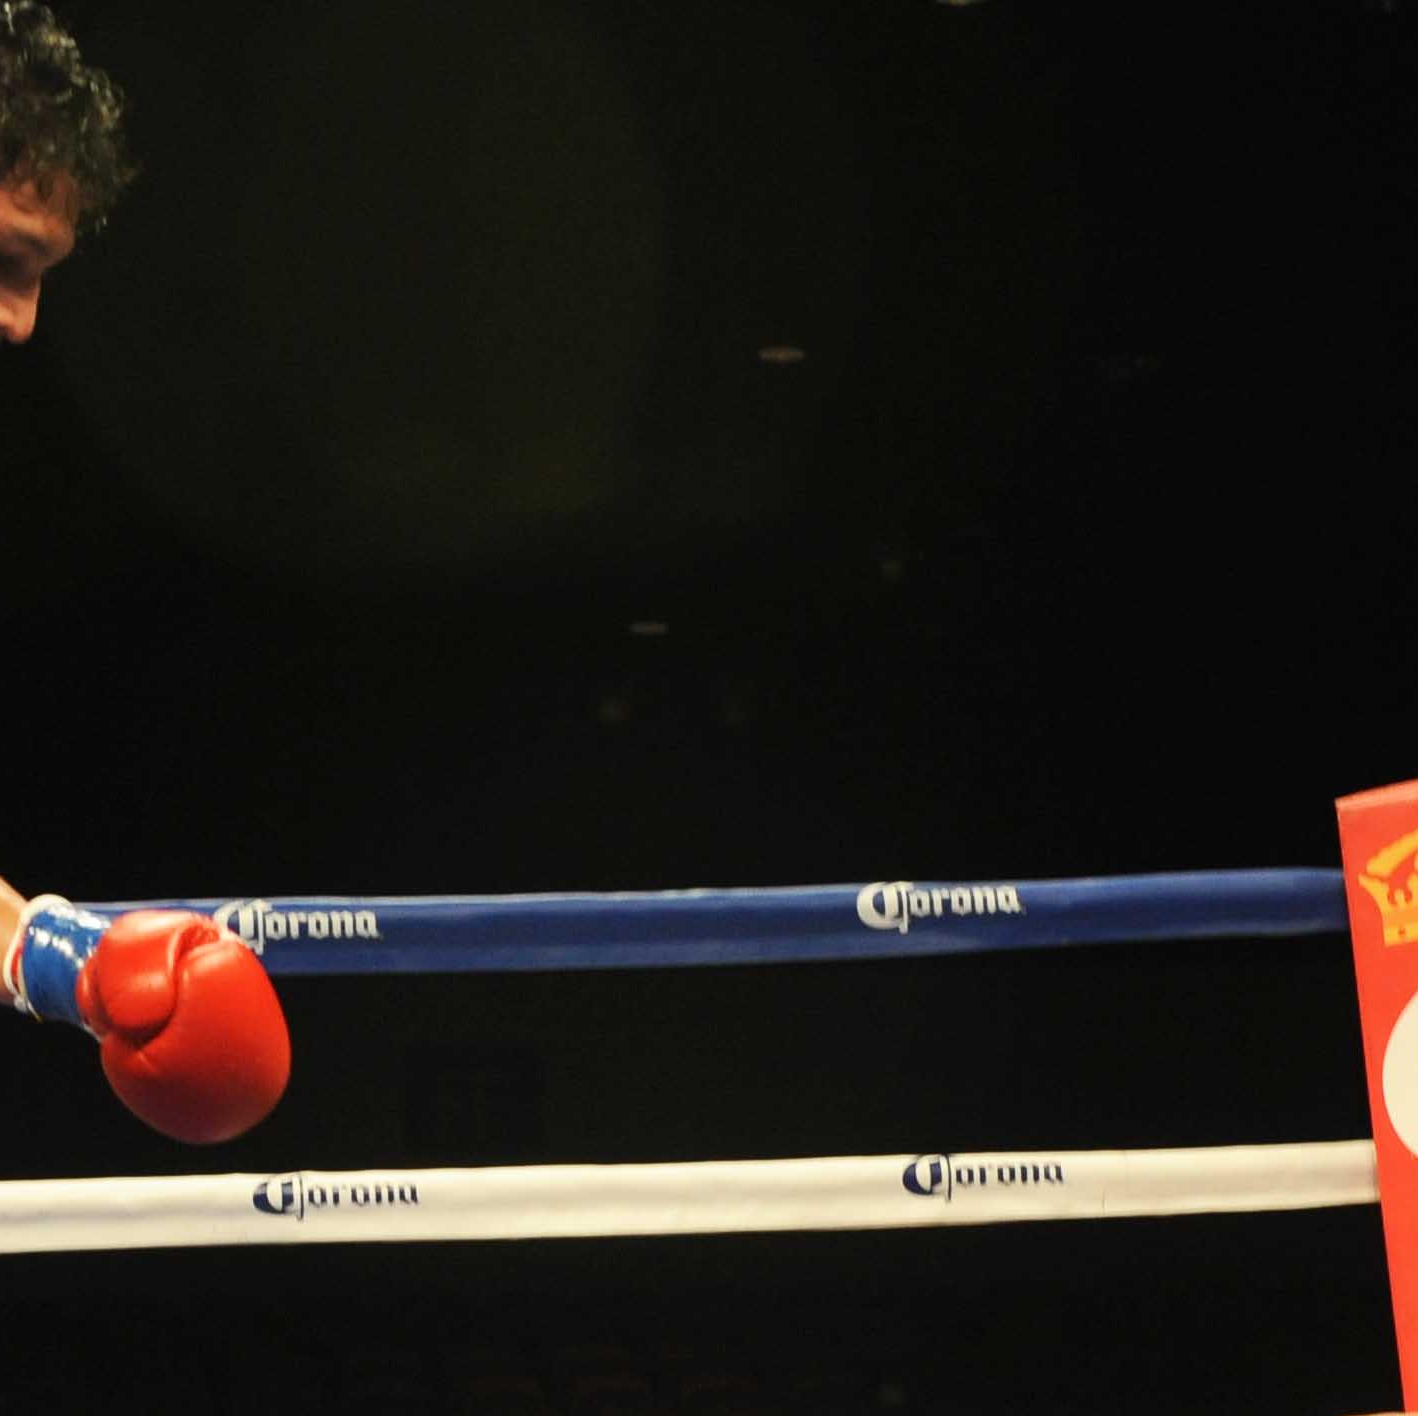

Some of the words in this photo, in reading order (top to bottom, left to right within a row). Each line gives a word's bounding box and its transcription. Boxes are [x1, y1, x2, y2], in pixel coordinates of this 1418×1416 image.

[213, 900, 381, 954] Corona
[856, 881, 1024, 934] Corona
[253, 1172, 419, 1220] Corona
[902, 1153, 1064, 1202] Corona
